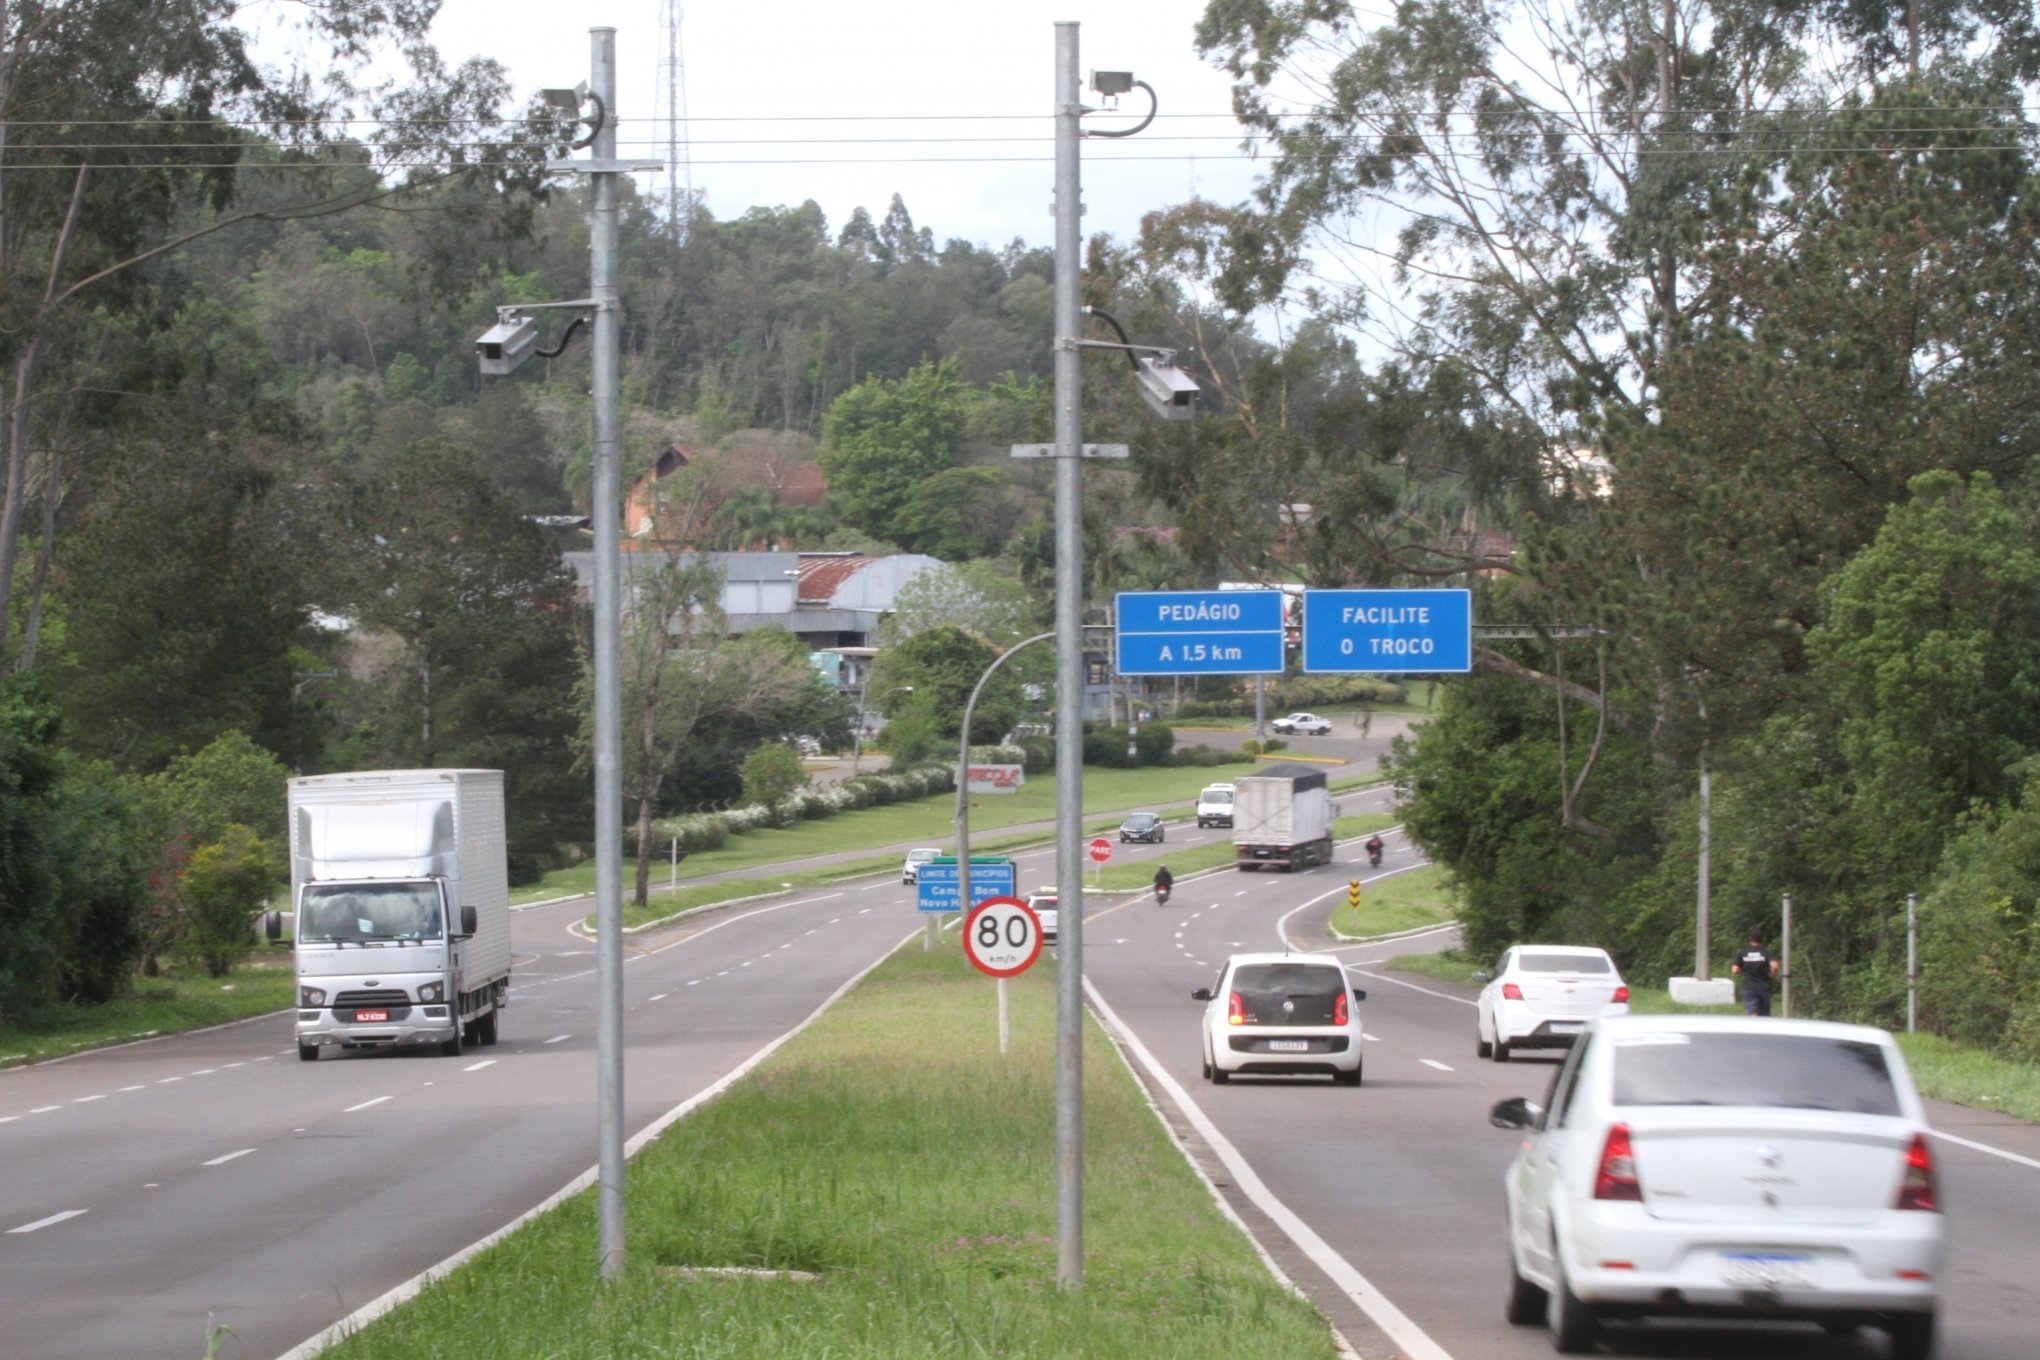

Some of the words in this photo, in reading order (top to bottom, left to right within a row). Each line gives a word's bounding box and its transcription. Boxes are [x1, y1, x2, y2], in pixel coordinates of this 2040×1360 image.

[1158, 601, 1241, 621] PEDÁGIO
[1342, 607, 1430, 623] FACILITE
[1159, 645, 1173, 661] A
[1211, 644, 1242, 660] km
[1340, 638, 1354, 655] O
[1370, 638, 1435, 655] TROCO
[1090, 845, 1112, 856] PARE
[920, 869, 946, 878] LIMITE
[974, 886, 999, 895] Bom
[920, 898, 948, 907] Novo
[978, 915, 1027, 948] 80
[989, 954, 1017, 963] km/h
